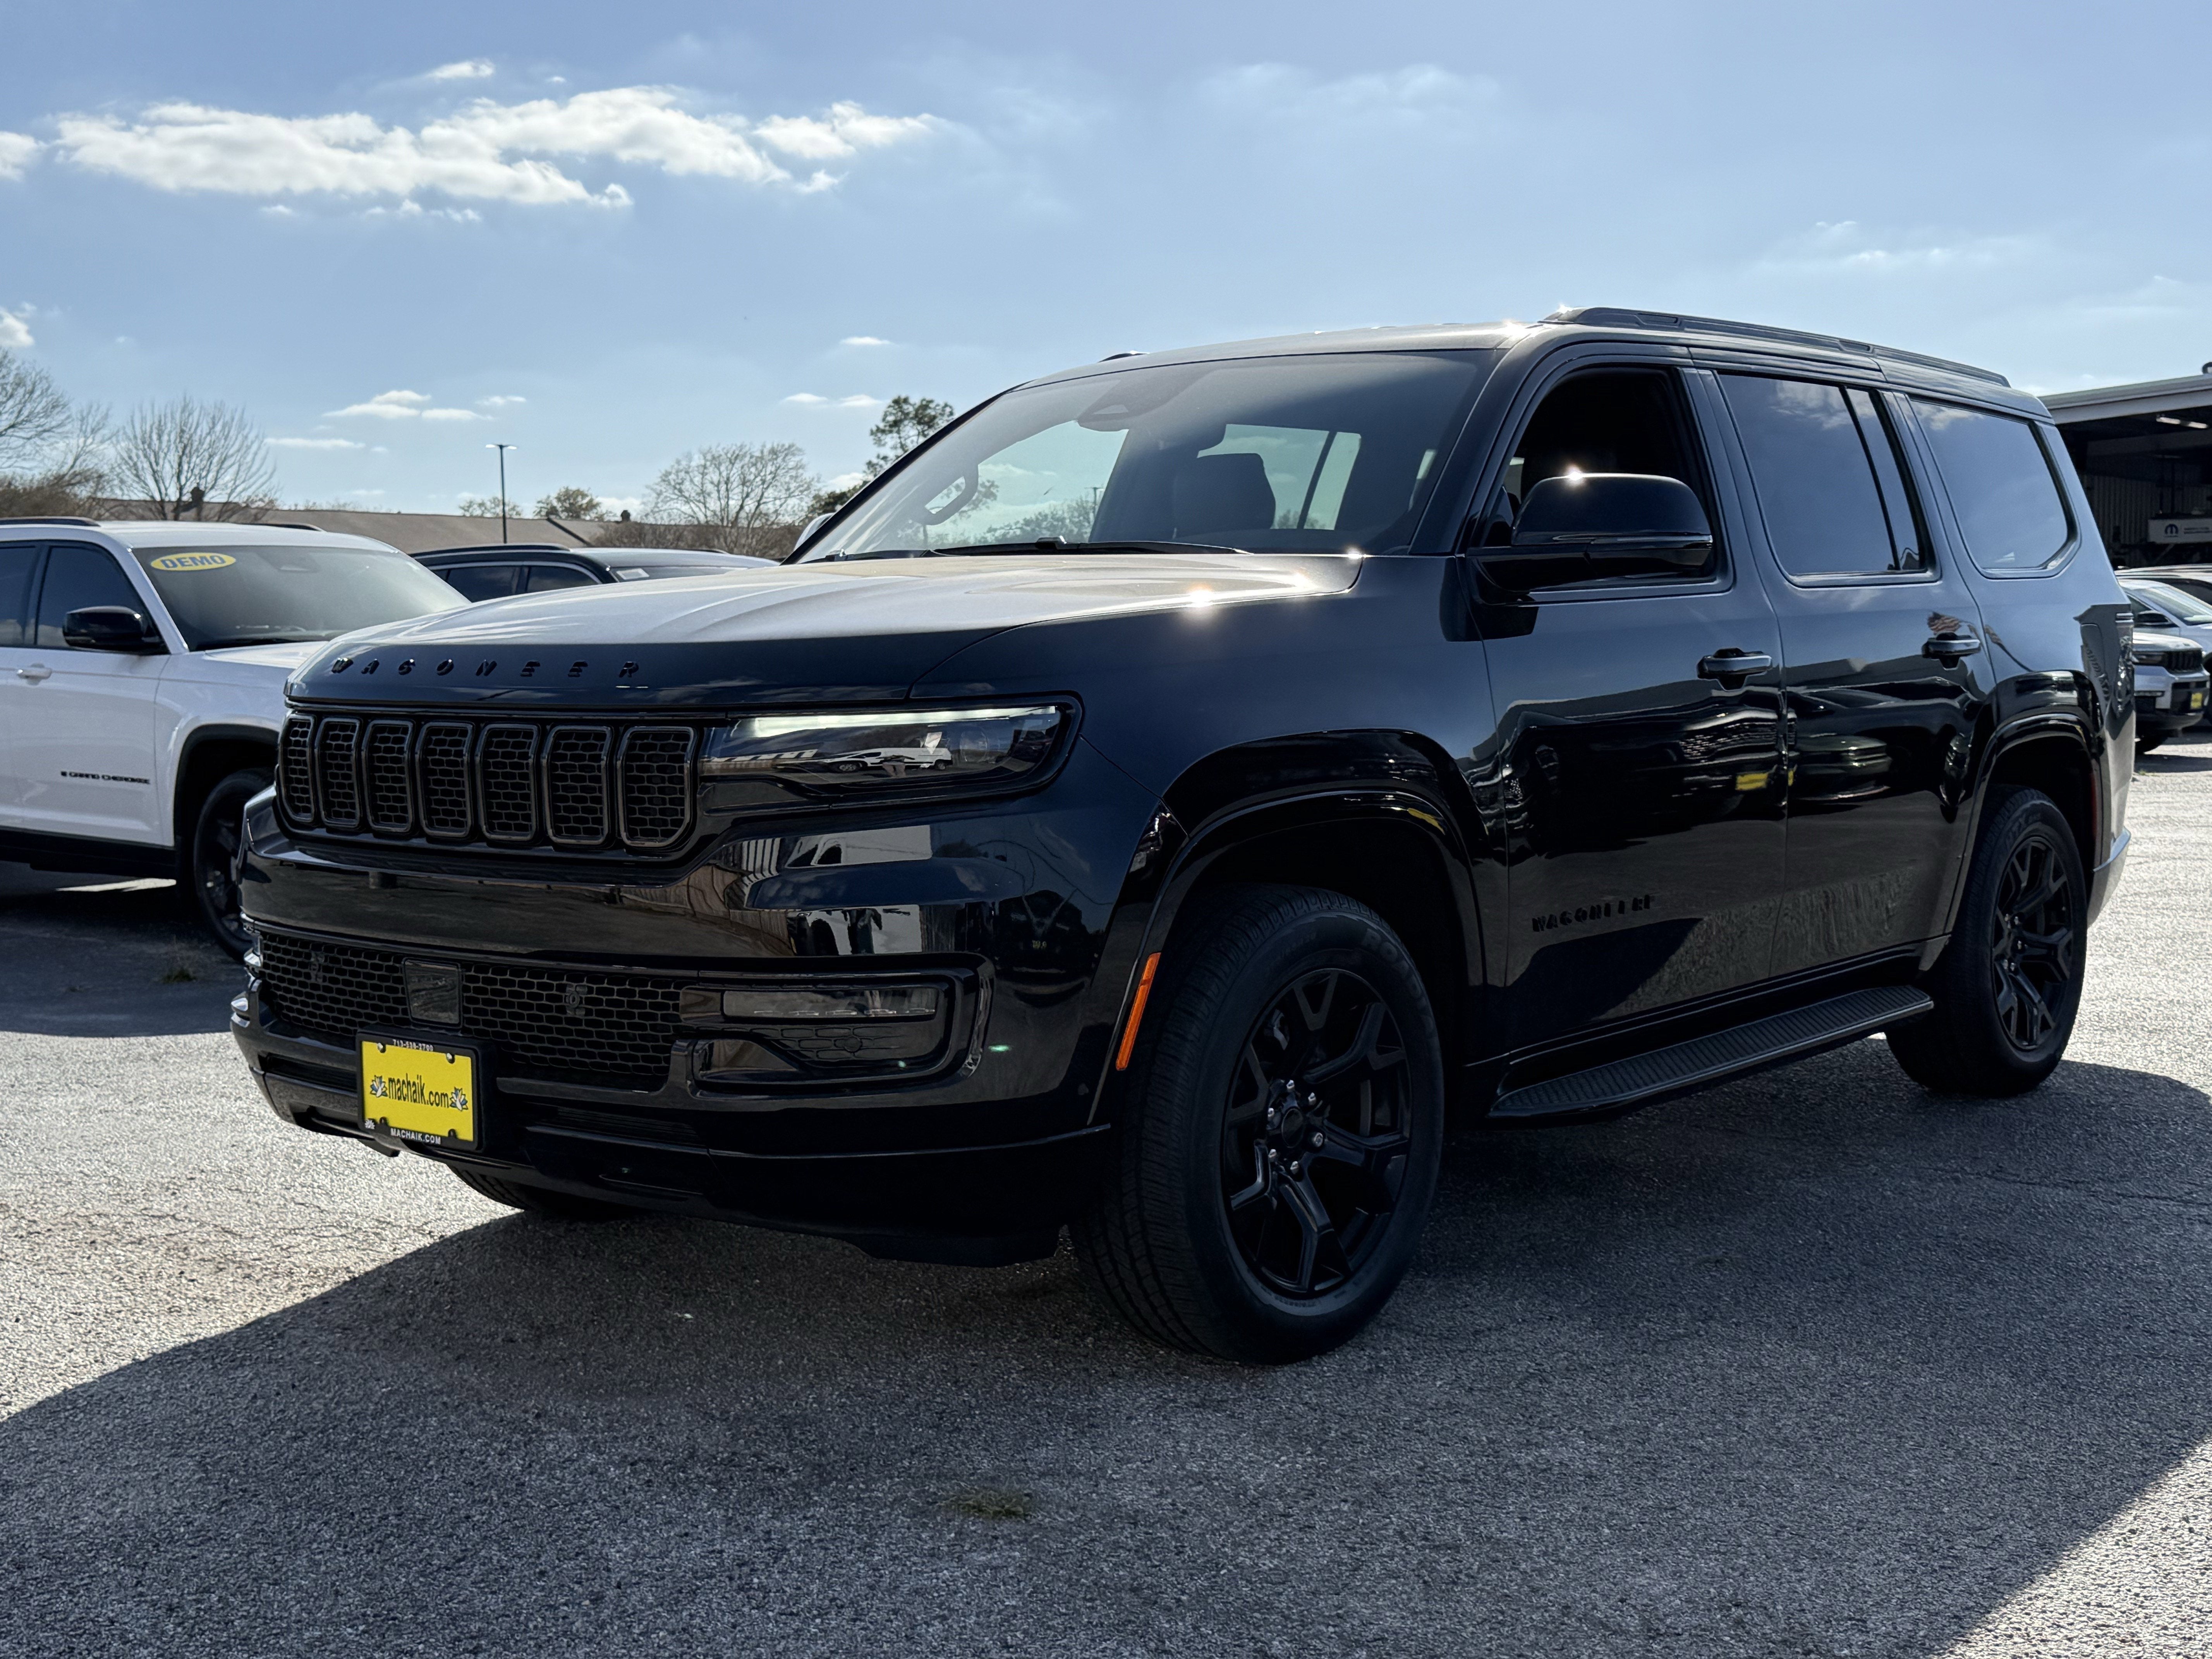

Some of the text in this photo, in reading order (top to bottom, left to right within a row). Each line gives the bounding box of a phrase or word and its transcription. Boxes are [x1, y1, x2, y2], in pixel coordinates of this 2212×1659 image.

[160, 555, 226, 568] DEMO
[331, 657, 639, 678] WAGONEER
[388, 1073, 449, 1108] machaik.com
[390, 1128, 441, 1145] MACHAIK.COM
